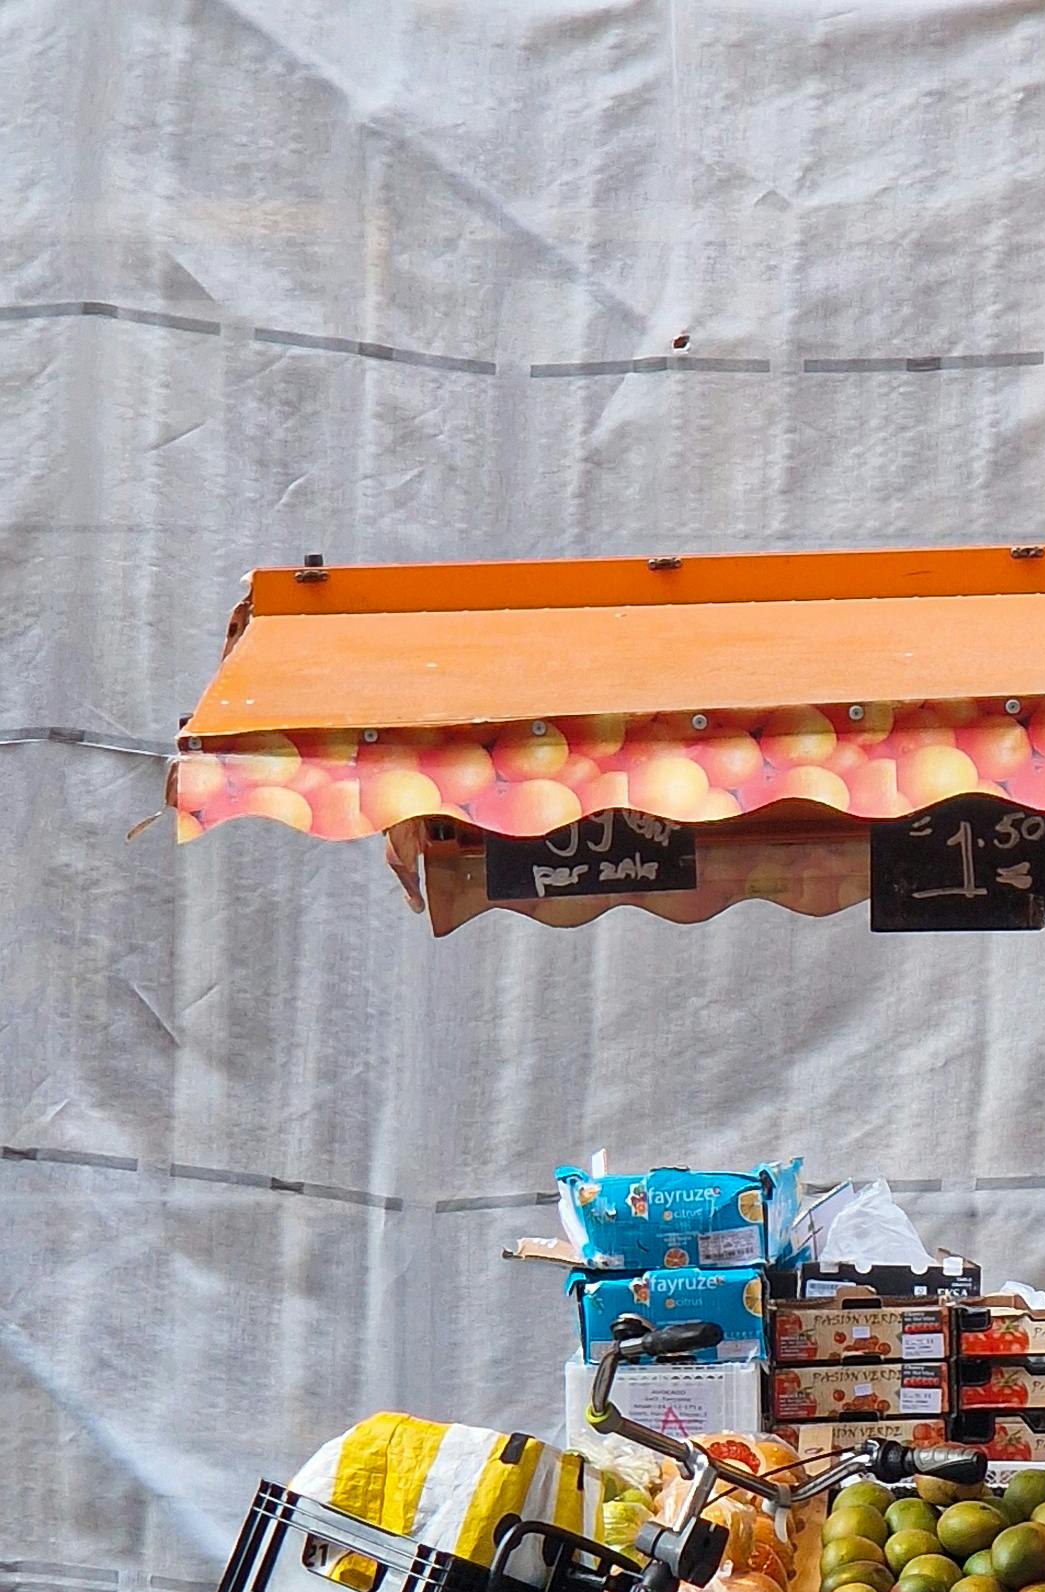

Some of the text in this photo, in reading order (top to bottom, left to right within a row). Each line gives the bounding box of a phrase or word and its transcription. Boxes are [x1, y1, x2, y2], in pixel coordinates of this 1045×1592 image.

[533, 865, 589, 897] per
[648, 1187, 715, 1208] fayruze
[651, 1276, 717, 1294] fayruze
